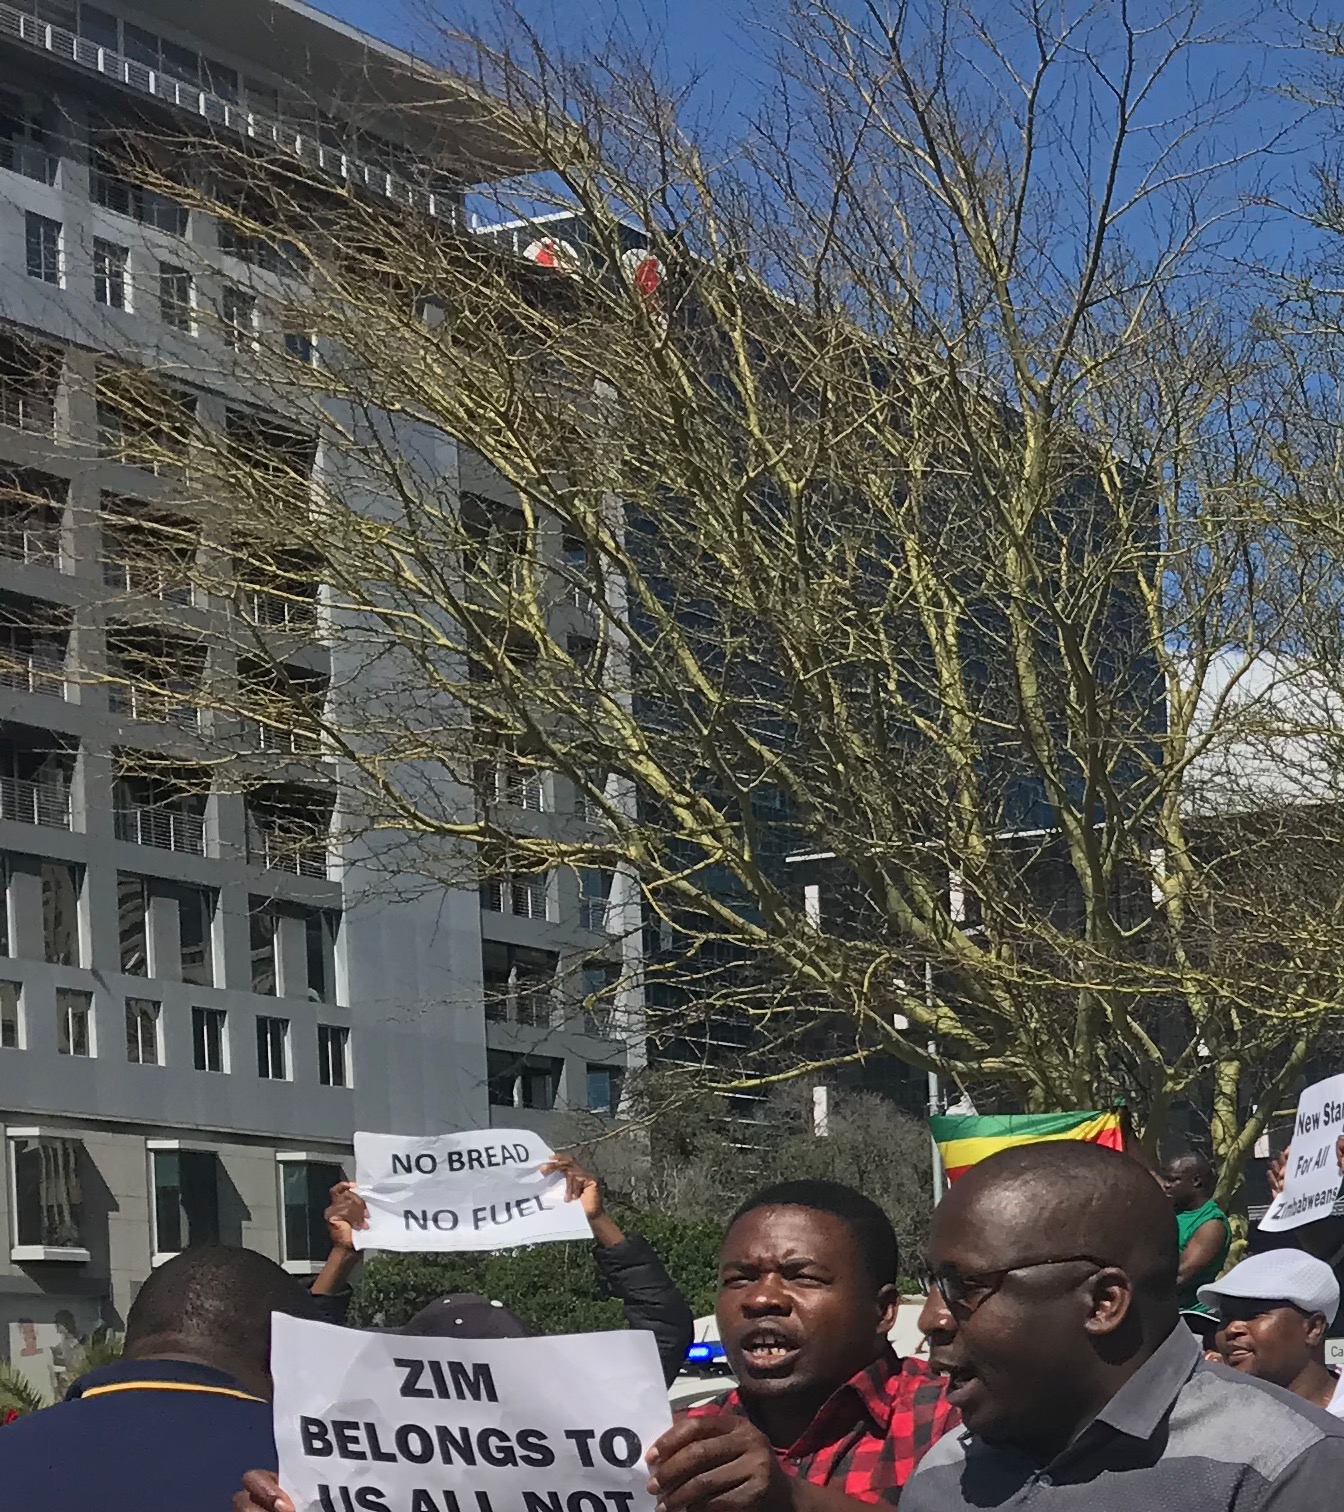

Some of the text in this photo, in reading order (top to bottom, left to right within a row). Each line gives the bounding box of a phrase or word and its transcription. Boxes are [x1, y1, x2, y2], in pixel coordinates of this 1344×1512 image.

[1297, 1111, 1320, 1136] New
[392, 1143, 529, 1174] NO BREAD
[1294, 1145, 1331, 1179] For All
[403, 1195, 554, 1231] NO FUEL
[1271, 1186, 1338, 1220] Zimbabweans
[394, 1357, 499, 1404] ZIM
[300, 1415, 642, 1469] BELONGS TO
